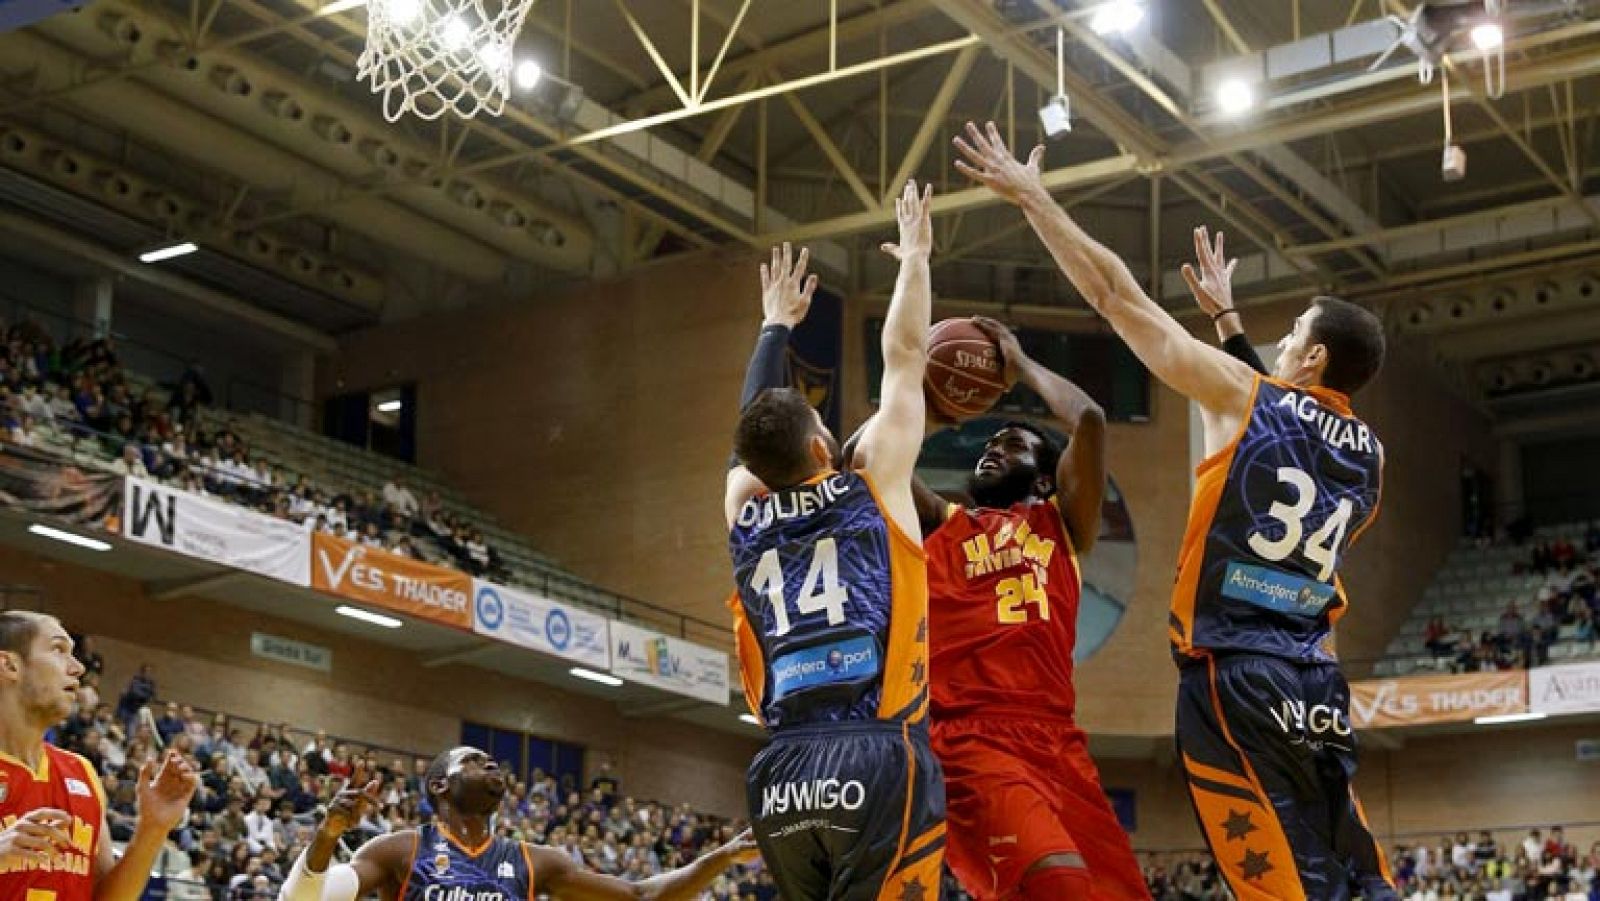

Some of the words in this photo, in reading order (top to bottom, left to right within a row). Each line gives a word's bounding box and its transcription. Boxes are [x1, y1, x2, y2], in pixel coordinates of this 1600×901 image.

[1248, 467, 1353, 582] 34
[751, 537, 849, 636] 14
[996, 573, 1050, 625] 24
